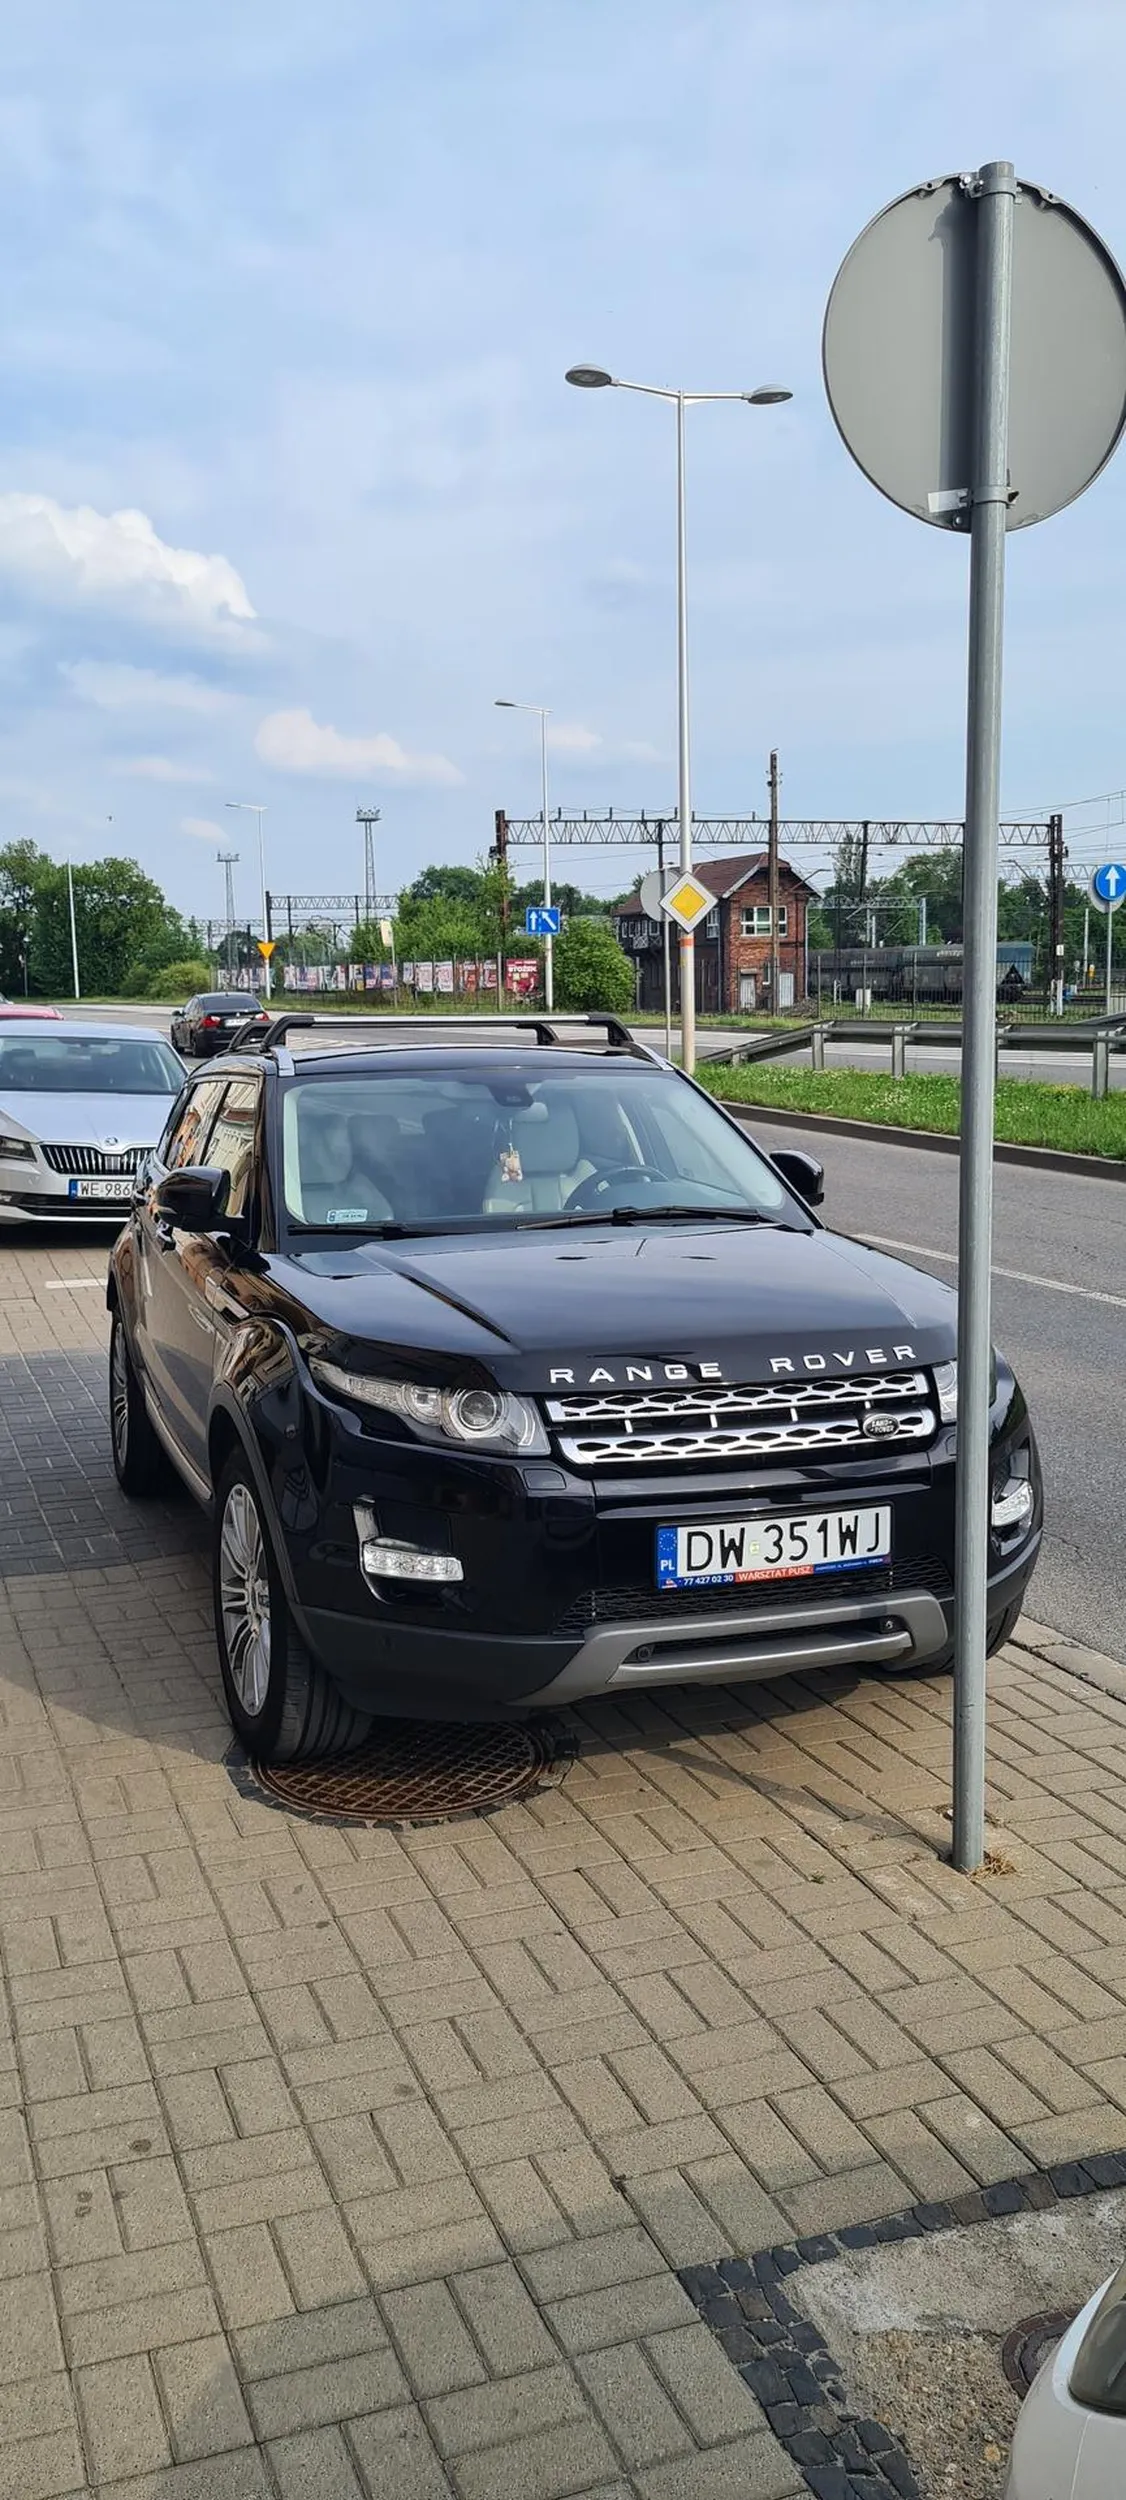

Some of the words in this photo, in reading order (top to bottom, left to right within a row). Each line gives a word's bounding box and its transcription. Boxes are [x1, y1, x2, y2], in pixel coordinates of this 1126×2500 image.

[81, 1183, 99, 1196] WE
[549, 1362, 722, 1384] RANGE
[769, 1345, 916, 1373] ROVER
[687, 1527, 745, 1571] DW
[764, 1512, 879, 1563] 351WJ
[660, 1559, 675, 1571] PL
[684, 1577, 694, 1585] 77
[695, 1576, 709, 1585] 427
[712, 1575, 722, 1583] 02
[725, 1574, 734, 1582] 30
[739, 1568, 787, 1580] WARSZTAT
[789, 1565, 812, 1576] PUSZ
